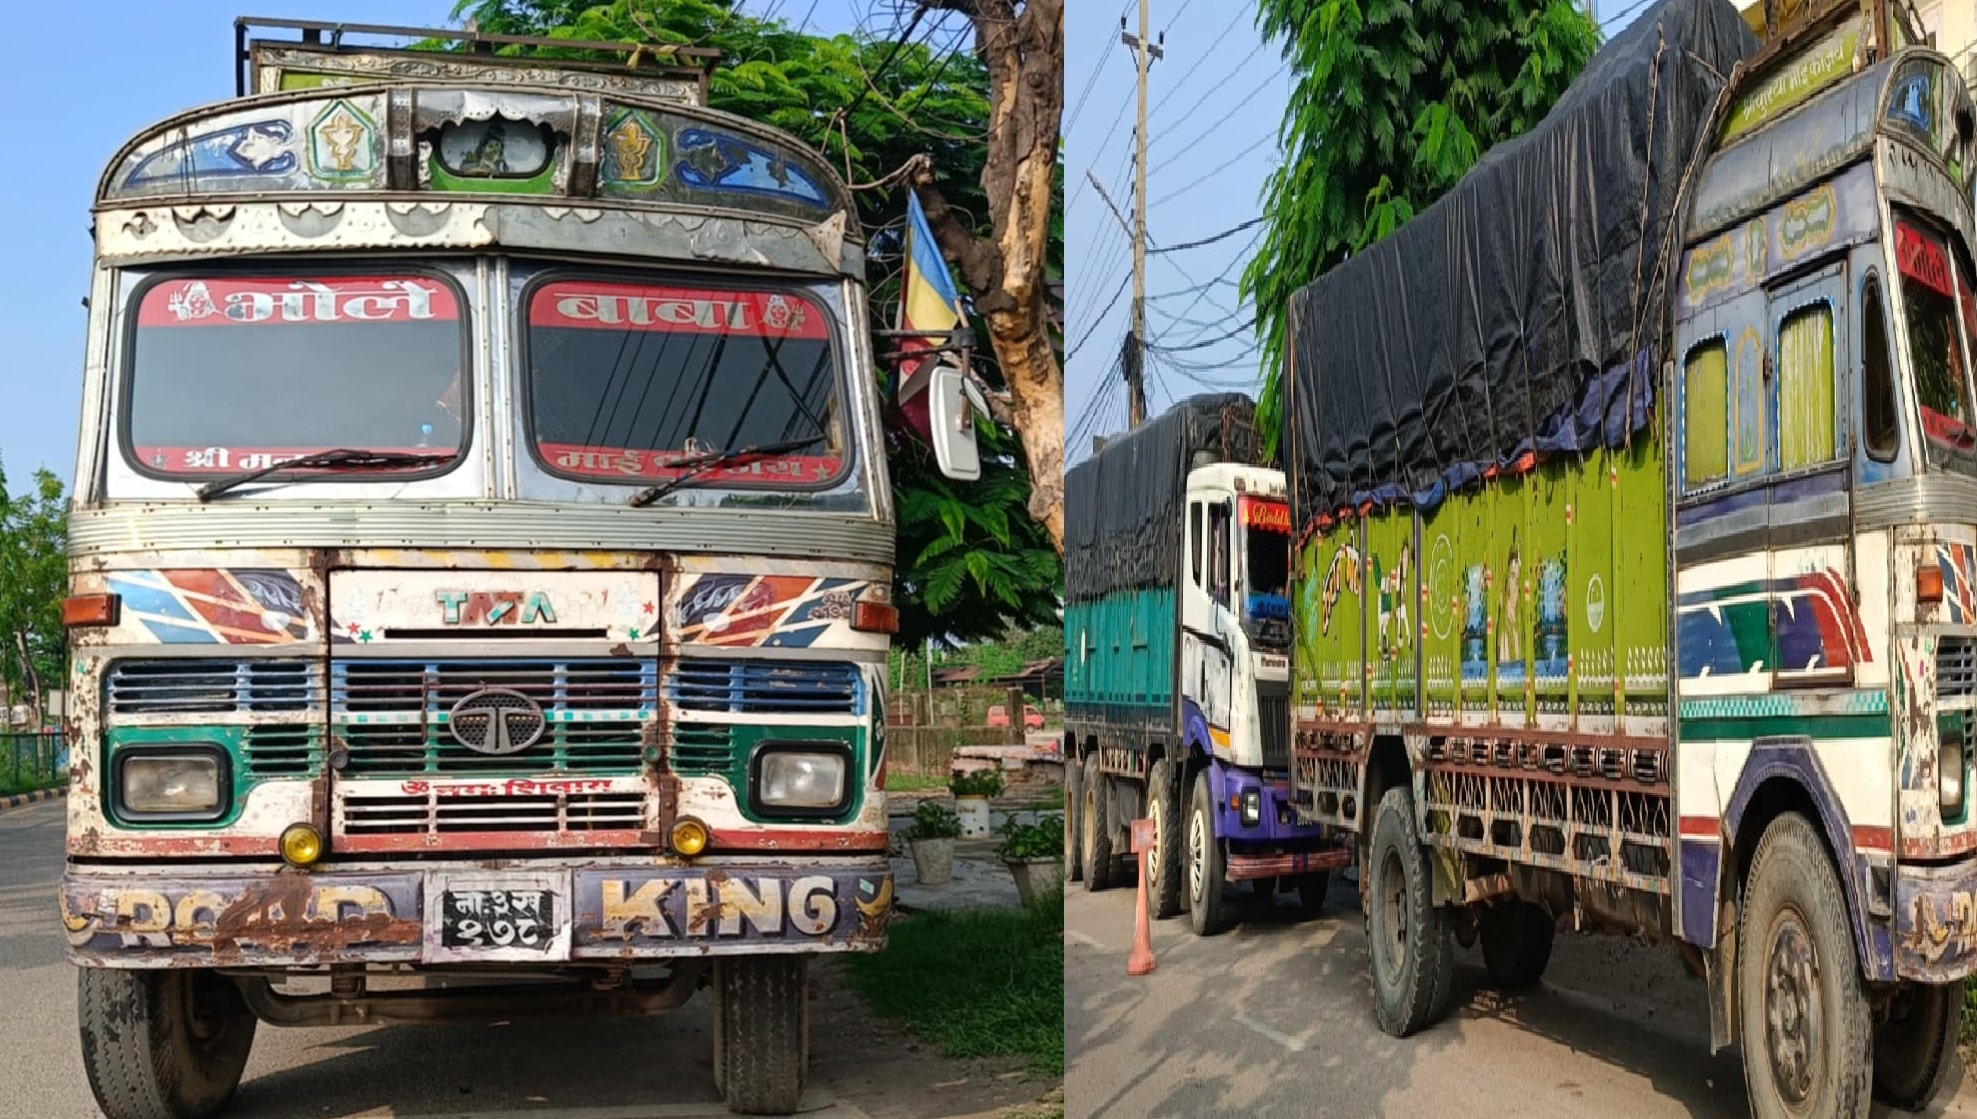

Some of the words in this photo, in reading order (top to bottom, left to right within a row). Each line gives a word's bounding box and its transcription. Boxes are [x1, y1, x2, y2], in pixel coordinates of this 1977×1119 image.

[224, 279, 438, 322] भोले
[184, 446, 232, 469] श्री
[436, 591, 558, 625] TATA
[601, 875, 838, 938] KING
